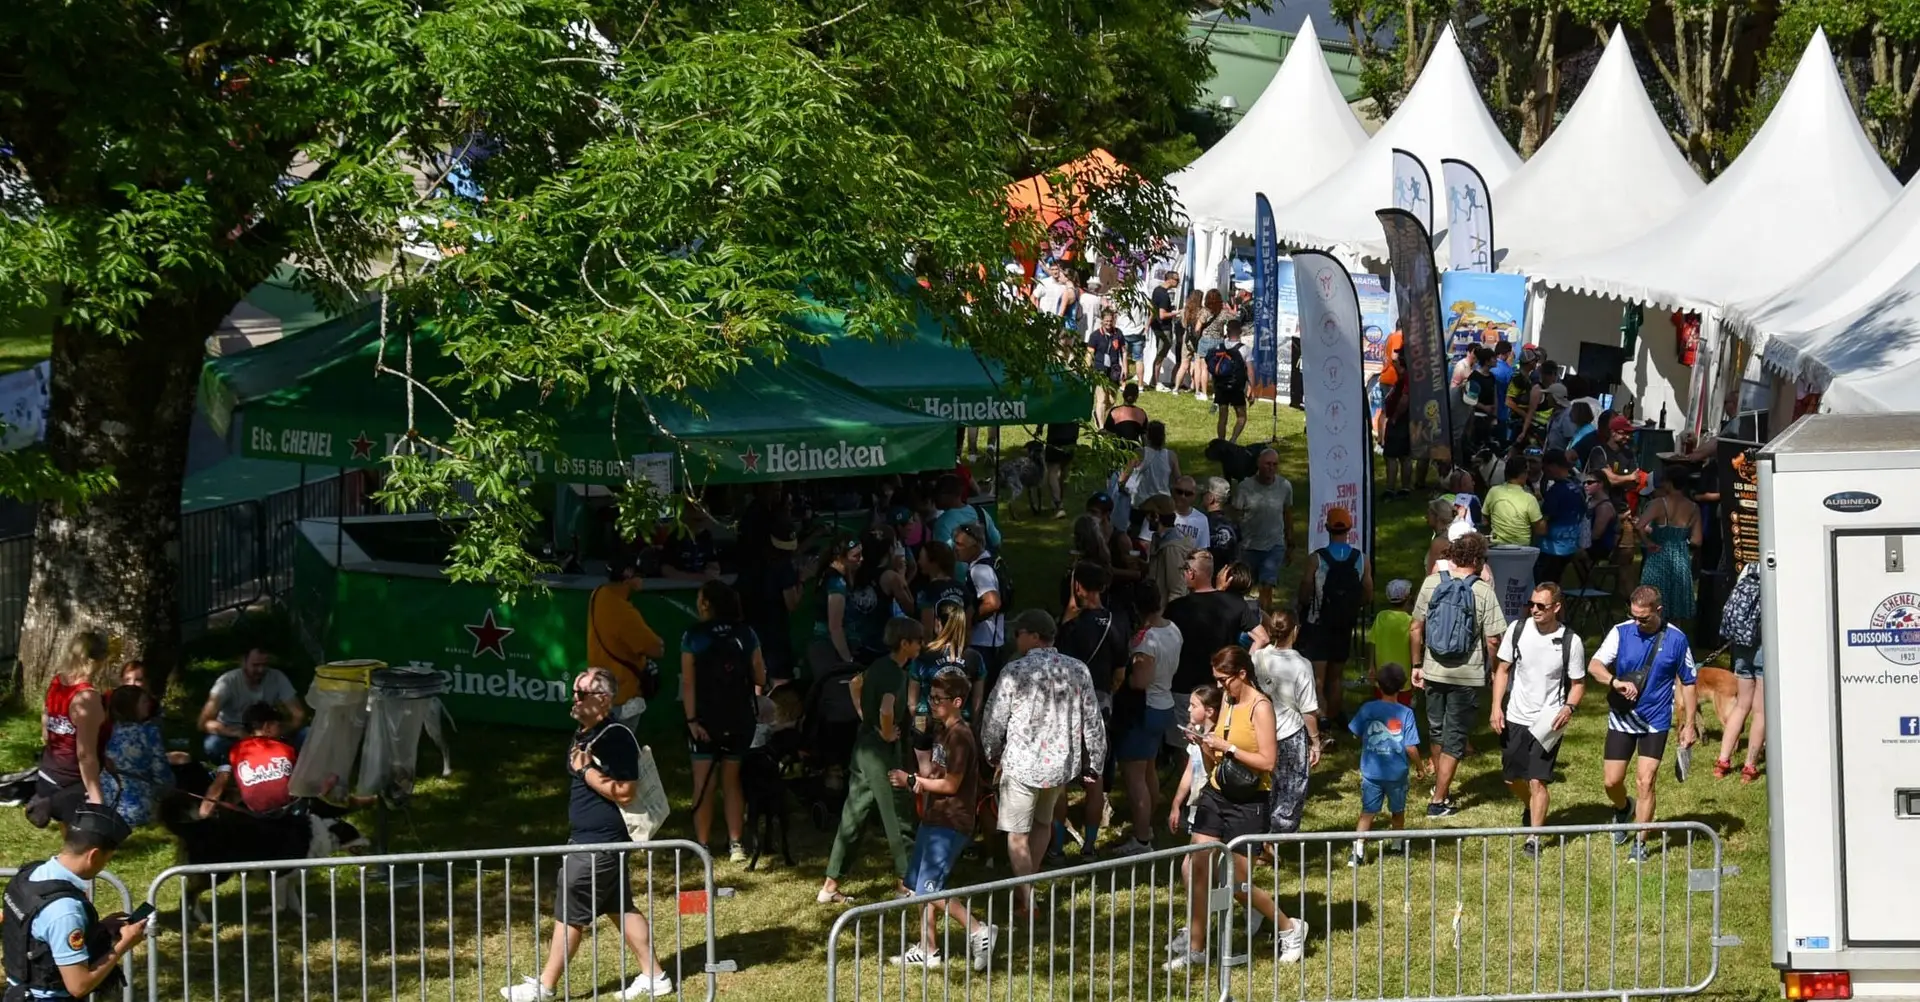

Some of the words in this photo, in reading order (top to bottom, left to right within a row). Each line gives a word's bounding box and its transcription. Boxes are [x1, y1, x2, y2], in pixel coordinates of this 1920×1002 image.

[924, 396, 1028, 421] Heineken
[281, 428, 333, 457] CHENEL
[766, 440, 887, 473] Heineken
[572, 457, 586, 476] 55
[589, 459, 604, 477] 56
[606, 460, 621, 477] 05
[1825, 498, 1879, 506] AUBINEAU
[1882, 594, 1915, 612] CHENEL
[1851, 632, 1893, 643] BOISSONS
[1900, 652, 1916, 661] 1923
[408, 660, 569, 703] eineken
